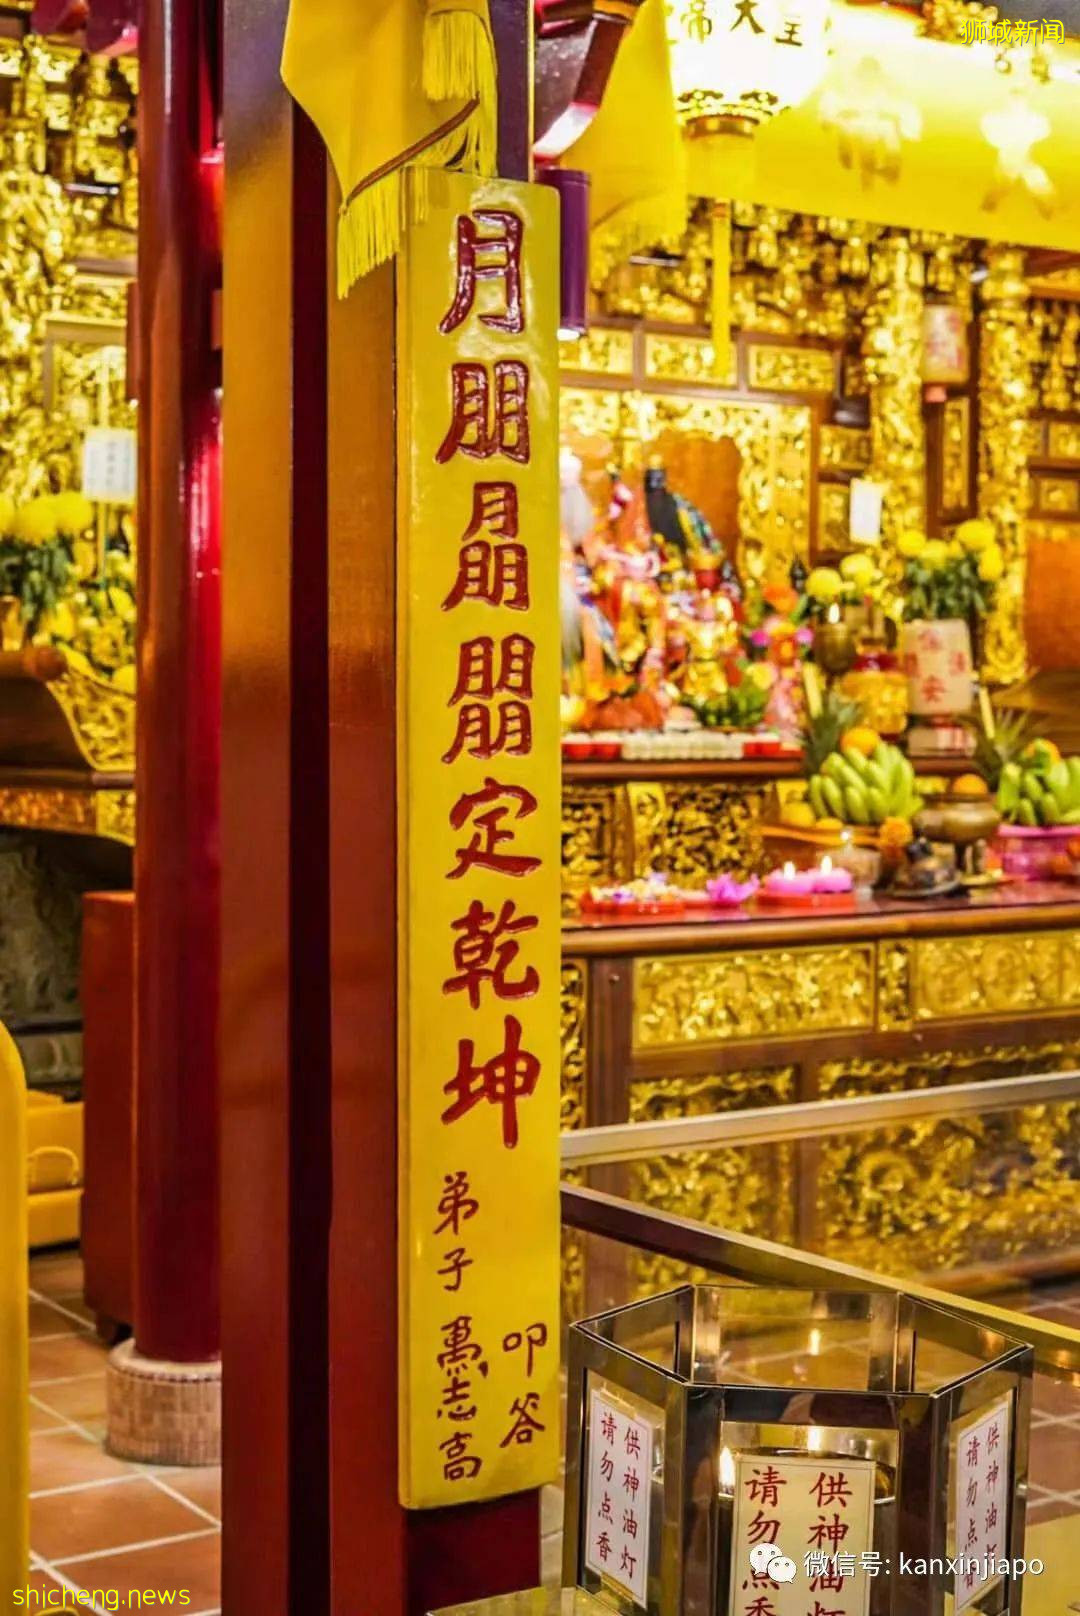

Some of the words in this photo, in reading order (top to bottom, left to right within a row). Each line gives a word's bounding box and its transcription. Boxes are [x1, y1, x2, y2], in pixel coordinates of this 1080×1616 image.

[595, 1411, 618, 1563] 请勿点香
[619, 1425, 642, 1580] 供神油灯
